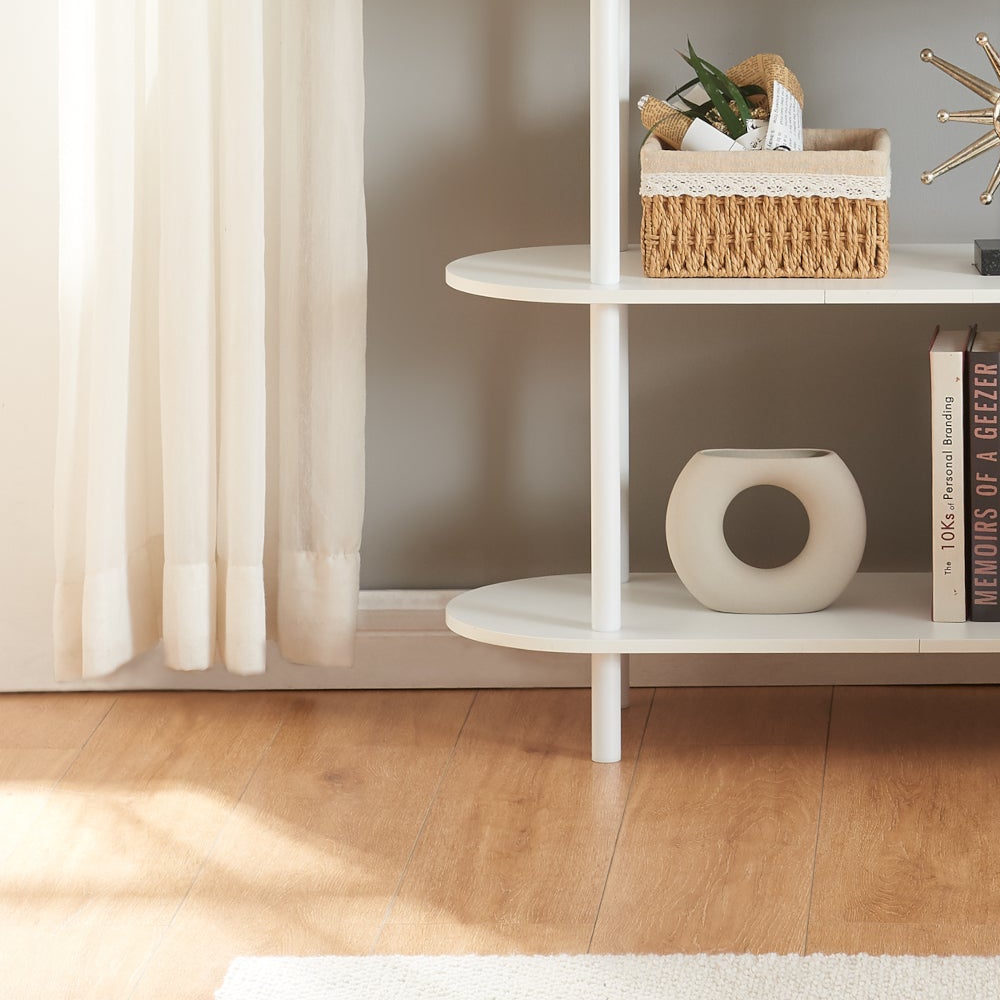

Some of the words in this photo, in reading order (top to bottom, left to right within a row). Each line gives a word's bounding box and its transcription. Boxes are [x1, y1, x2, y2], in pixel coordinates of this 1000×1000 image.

[974, 363, 998, 440] GEEZER
[942, 396, 955, 446] Branding
[975, 451, 998, 462] A
[942, 451, 954, 500] Personal
[975, 472, 998, 497] OF
[949, 503, 955, 511] of
[941, 513, 955, 550] 10Ks
[944, 561, 952, 575] The
[974, 508, 998, 605] MEMOIRS
